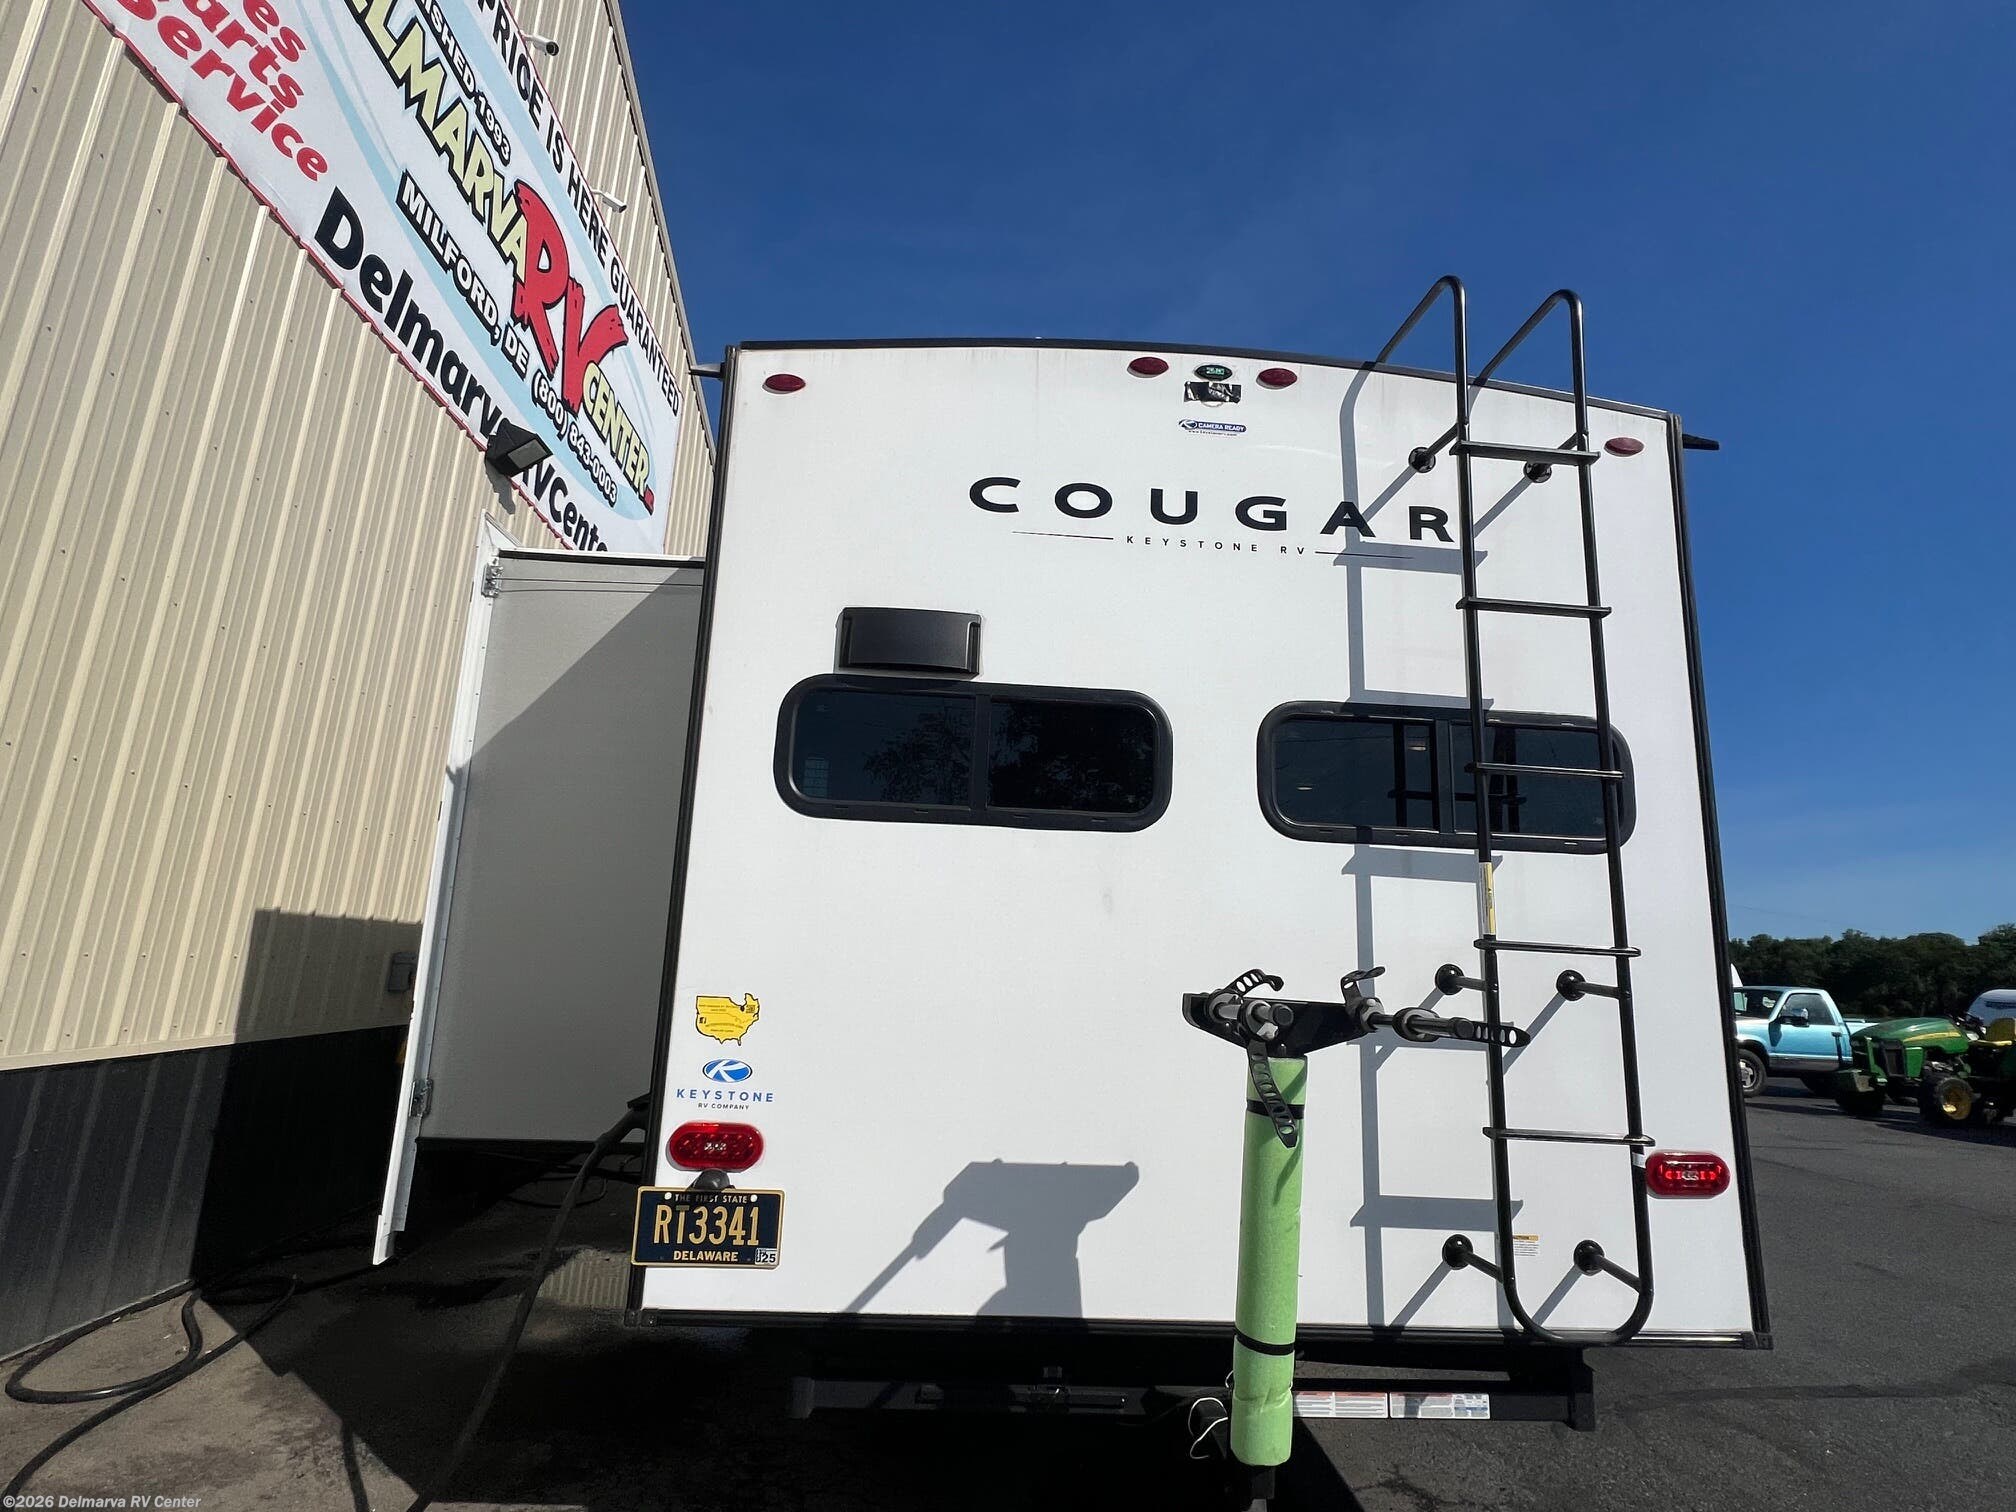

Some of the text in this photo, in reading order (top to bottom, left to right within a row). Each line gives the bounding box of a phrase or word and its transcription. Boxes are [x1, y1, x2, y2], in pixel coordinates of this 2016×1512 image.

[180, 0, 304, 109] arts
[474, 91, 512, 167] 1993
[343, 0, 530, 286] LMARVA
[511, 178, 629, 418] RV
[546, 115, 565, 174] IS
[567, 161, 609, 269] HERE
[610, 257, 680, 417] GUARANTEED
[395, 167, 618, 508] MILFORD, DE (800) 843-0003
[969, 476, 1455, 543] COUGAR
[1126, 534, 1306, 556] KEYSTONE RV
[676, 1088, 775, 1103] KEYSTONE
[711, 1103, 751, 1111] COMPANY
[653, 1204, 760, 1246] RT3341
[722, 1195, 748, 1204] STATE
[673, 1250, 739, 1262] DELAWARE
